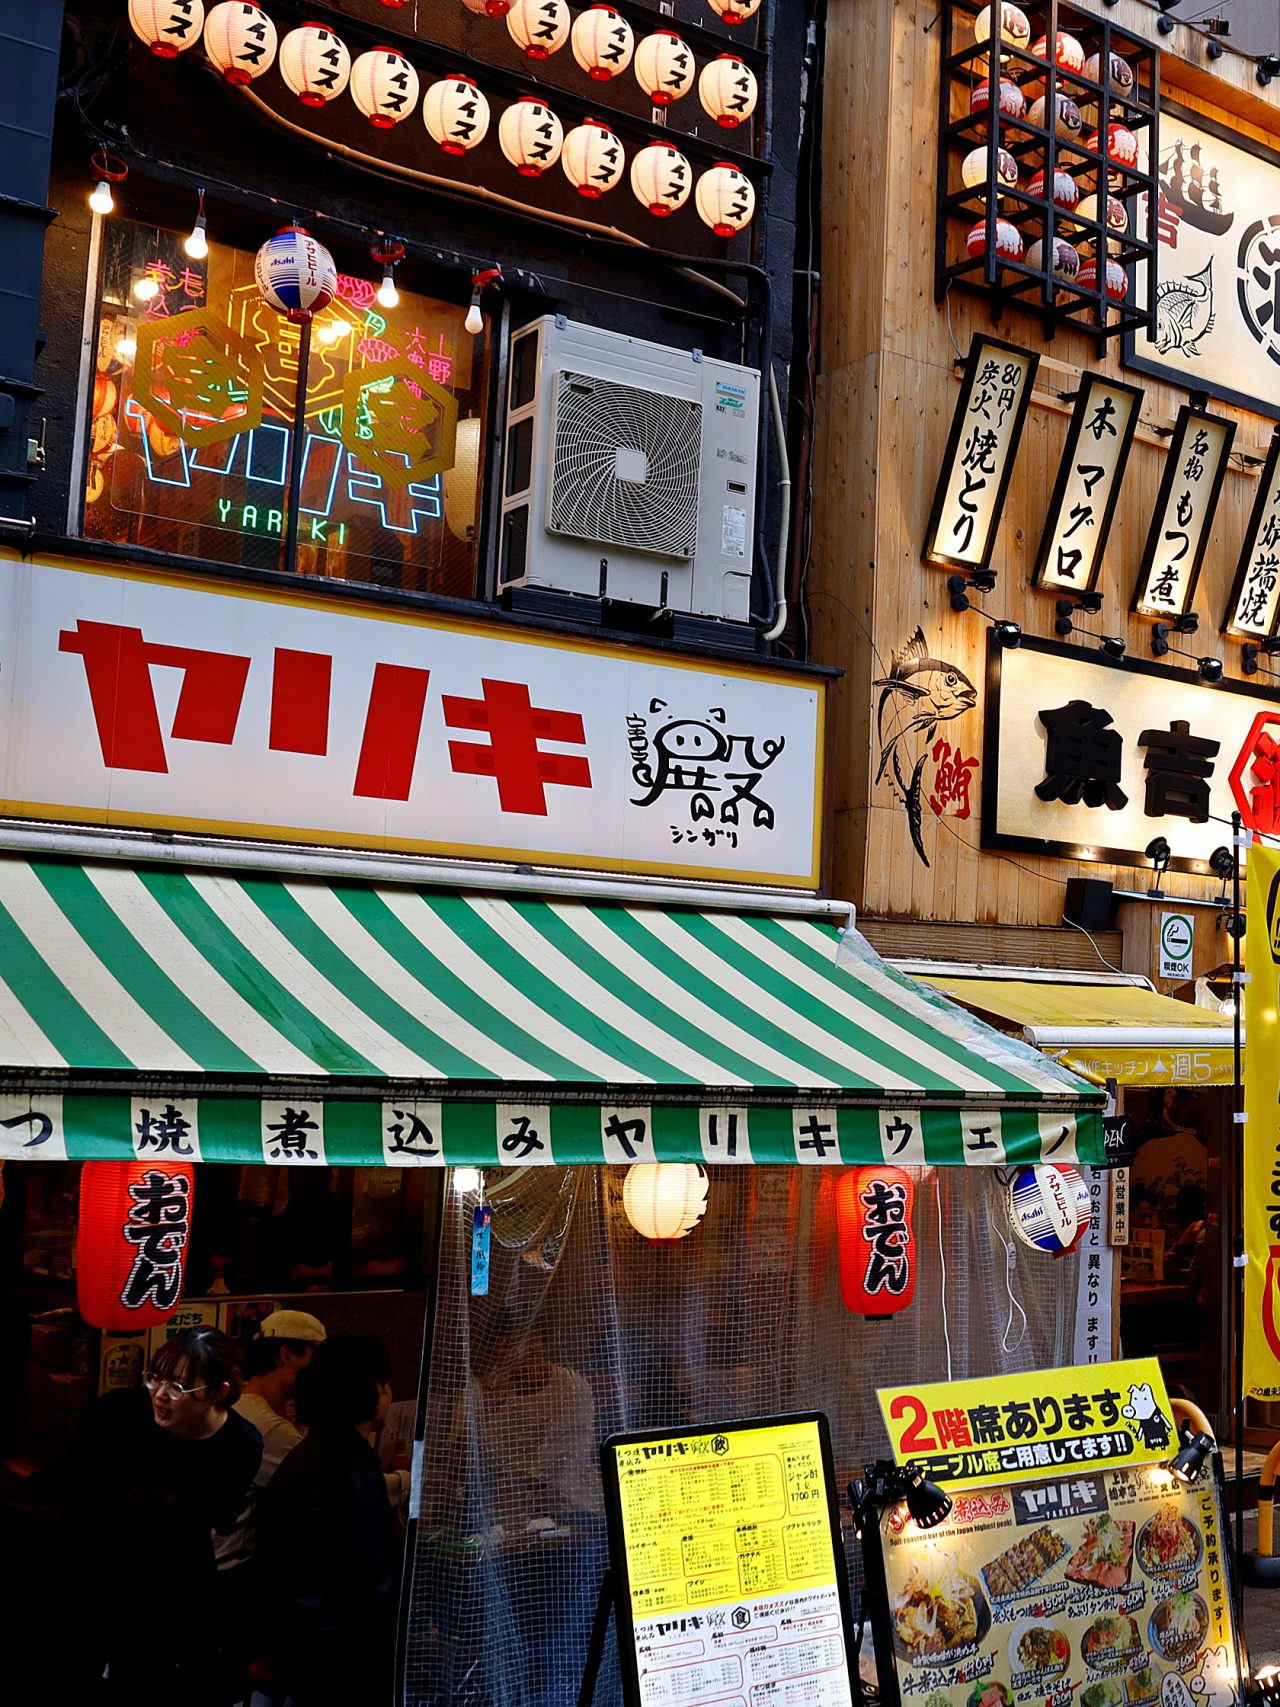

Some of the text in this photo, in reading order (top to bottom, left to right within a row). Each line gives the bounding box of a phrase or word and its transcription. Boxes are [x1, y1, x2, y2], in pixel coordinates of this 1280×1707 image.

[270, 256, 296, 267] Asahi
[305, 238, 318, 287] アサヒビール
[1056, 397, 1118, 580] 本マグロ
[218, 499, 346, 545] YARKI
[58, 619, 592, 816] ヤリキ
[1034, 699, 1222, 823] 魚吉
[669, 825, 739, 849] シンガリ
[1104, 1121, 1127, 1149] PEN
[1020, 1204, 1045, 1224] Asahi
[1045, 1173, 1072, 1228] アサヒビール
[1114, 1185, 1126, 1233] 営業中
[120, 1169, 190, 1311] おでん
[860, 1180, 910, 1296] おでん
[889, 1388, 1122, 1455] 2階席あります
[641, 1441, 689, 1460] ヤリキ
[1020, 1479, 1099, 1513] ヤリキ
[1045, 1506, 1081, 1519] YARIKI
[956, 1525, 974, 1537] Japan
[974, 1521, 997, 1534] highest
[1201, 1497, 1224, 1639] ご予約承ります!
[655, 1615, 704, 1637] ヤリキ
